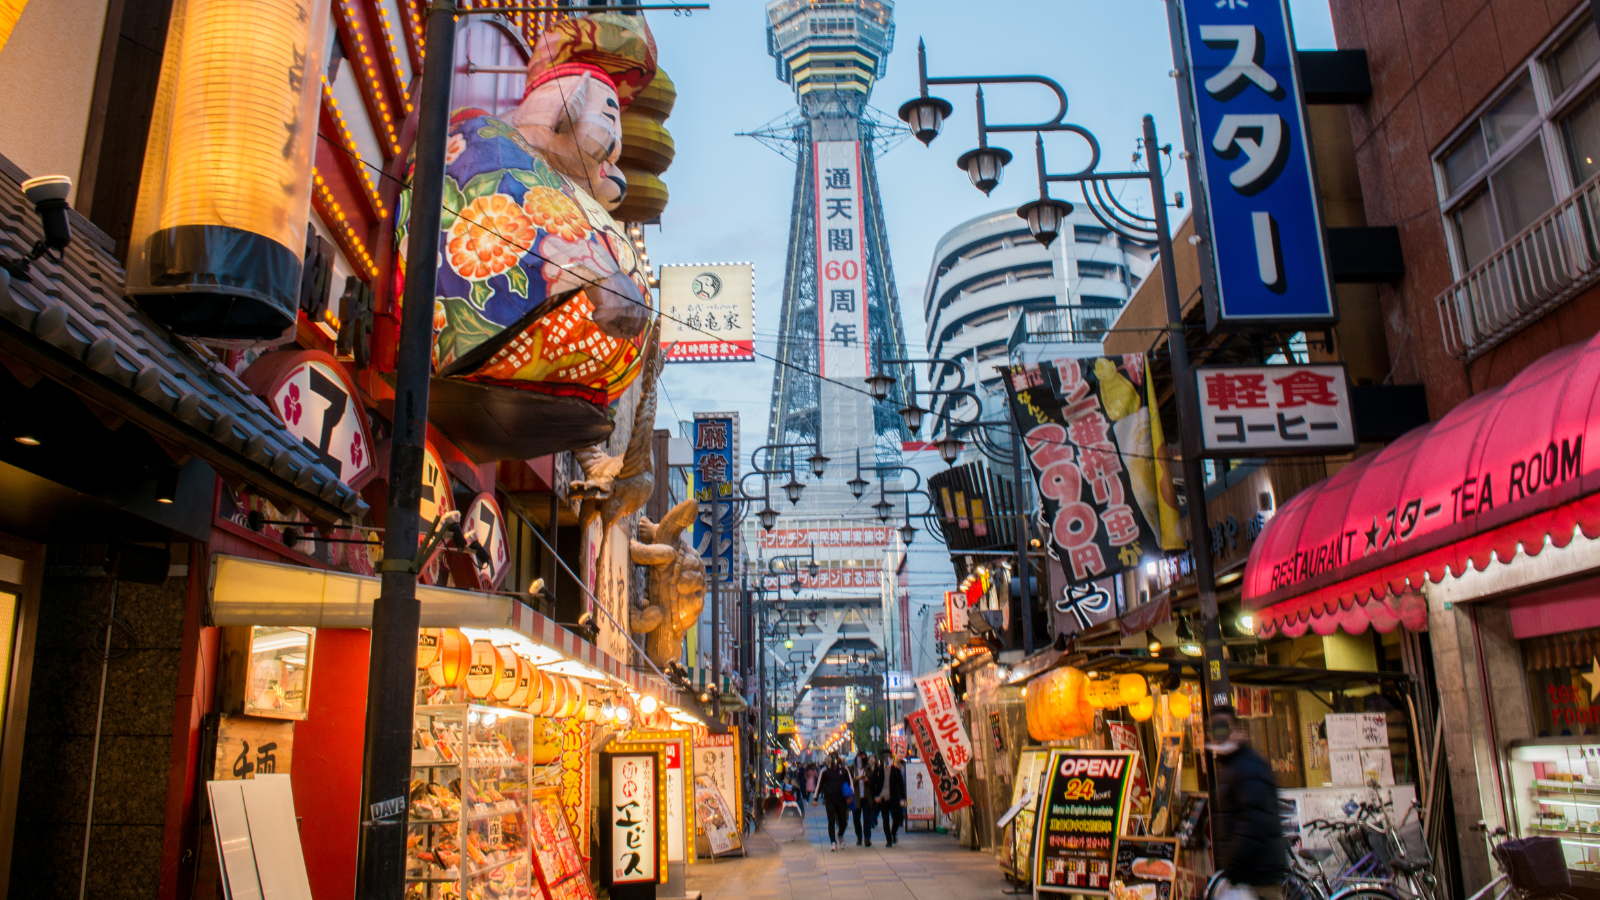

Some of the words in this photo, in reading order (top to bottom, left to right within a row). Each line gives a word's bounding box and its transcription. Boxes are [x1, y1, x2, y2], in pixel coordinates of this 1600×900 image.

[1199, 25, 1284, 288] スター
[824, 168, 859, 347] 通天閣60周年
[673, 342, 739, 356] 24時間営業中
[1204, 370, 1339, 411] 軽食
[1214, 412, 1339, 443] コーヒー
[696, 420, 729, 483] 麻雀
[696, 480, 732, 502] NEW
[1024, 422, 1106, 581] 290円
[1271, 530, 1357, 593] RESTAURANT
[1381, 497, 1442, 551] スター
[1452, 472, 1494, 524] TEA
[1508, 433, 1583, 504] ROOM
[1546, 683, 1581, 705] tea
[1551, 705, 1600, 727] room
[1060, 758, 1125, 779] OPEN!
[1064, 778, 1095, 800] 24
[1093, 789, 1112, 801] hours
[372, 796, 405, 818] DAVE
[1052, 803, 1065, 815] Menu
[1065, 804, 1070, 815] in
[1070, 804, 1087, 816] English
[1087, 804, 1092, 816] is
[1092, 805, 1114, 817] available
